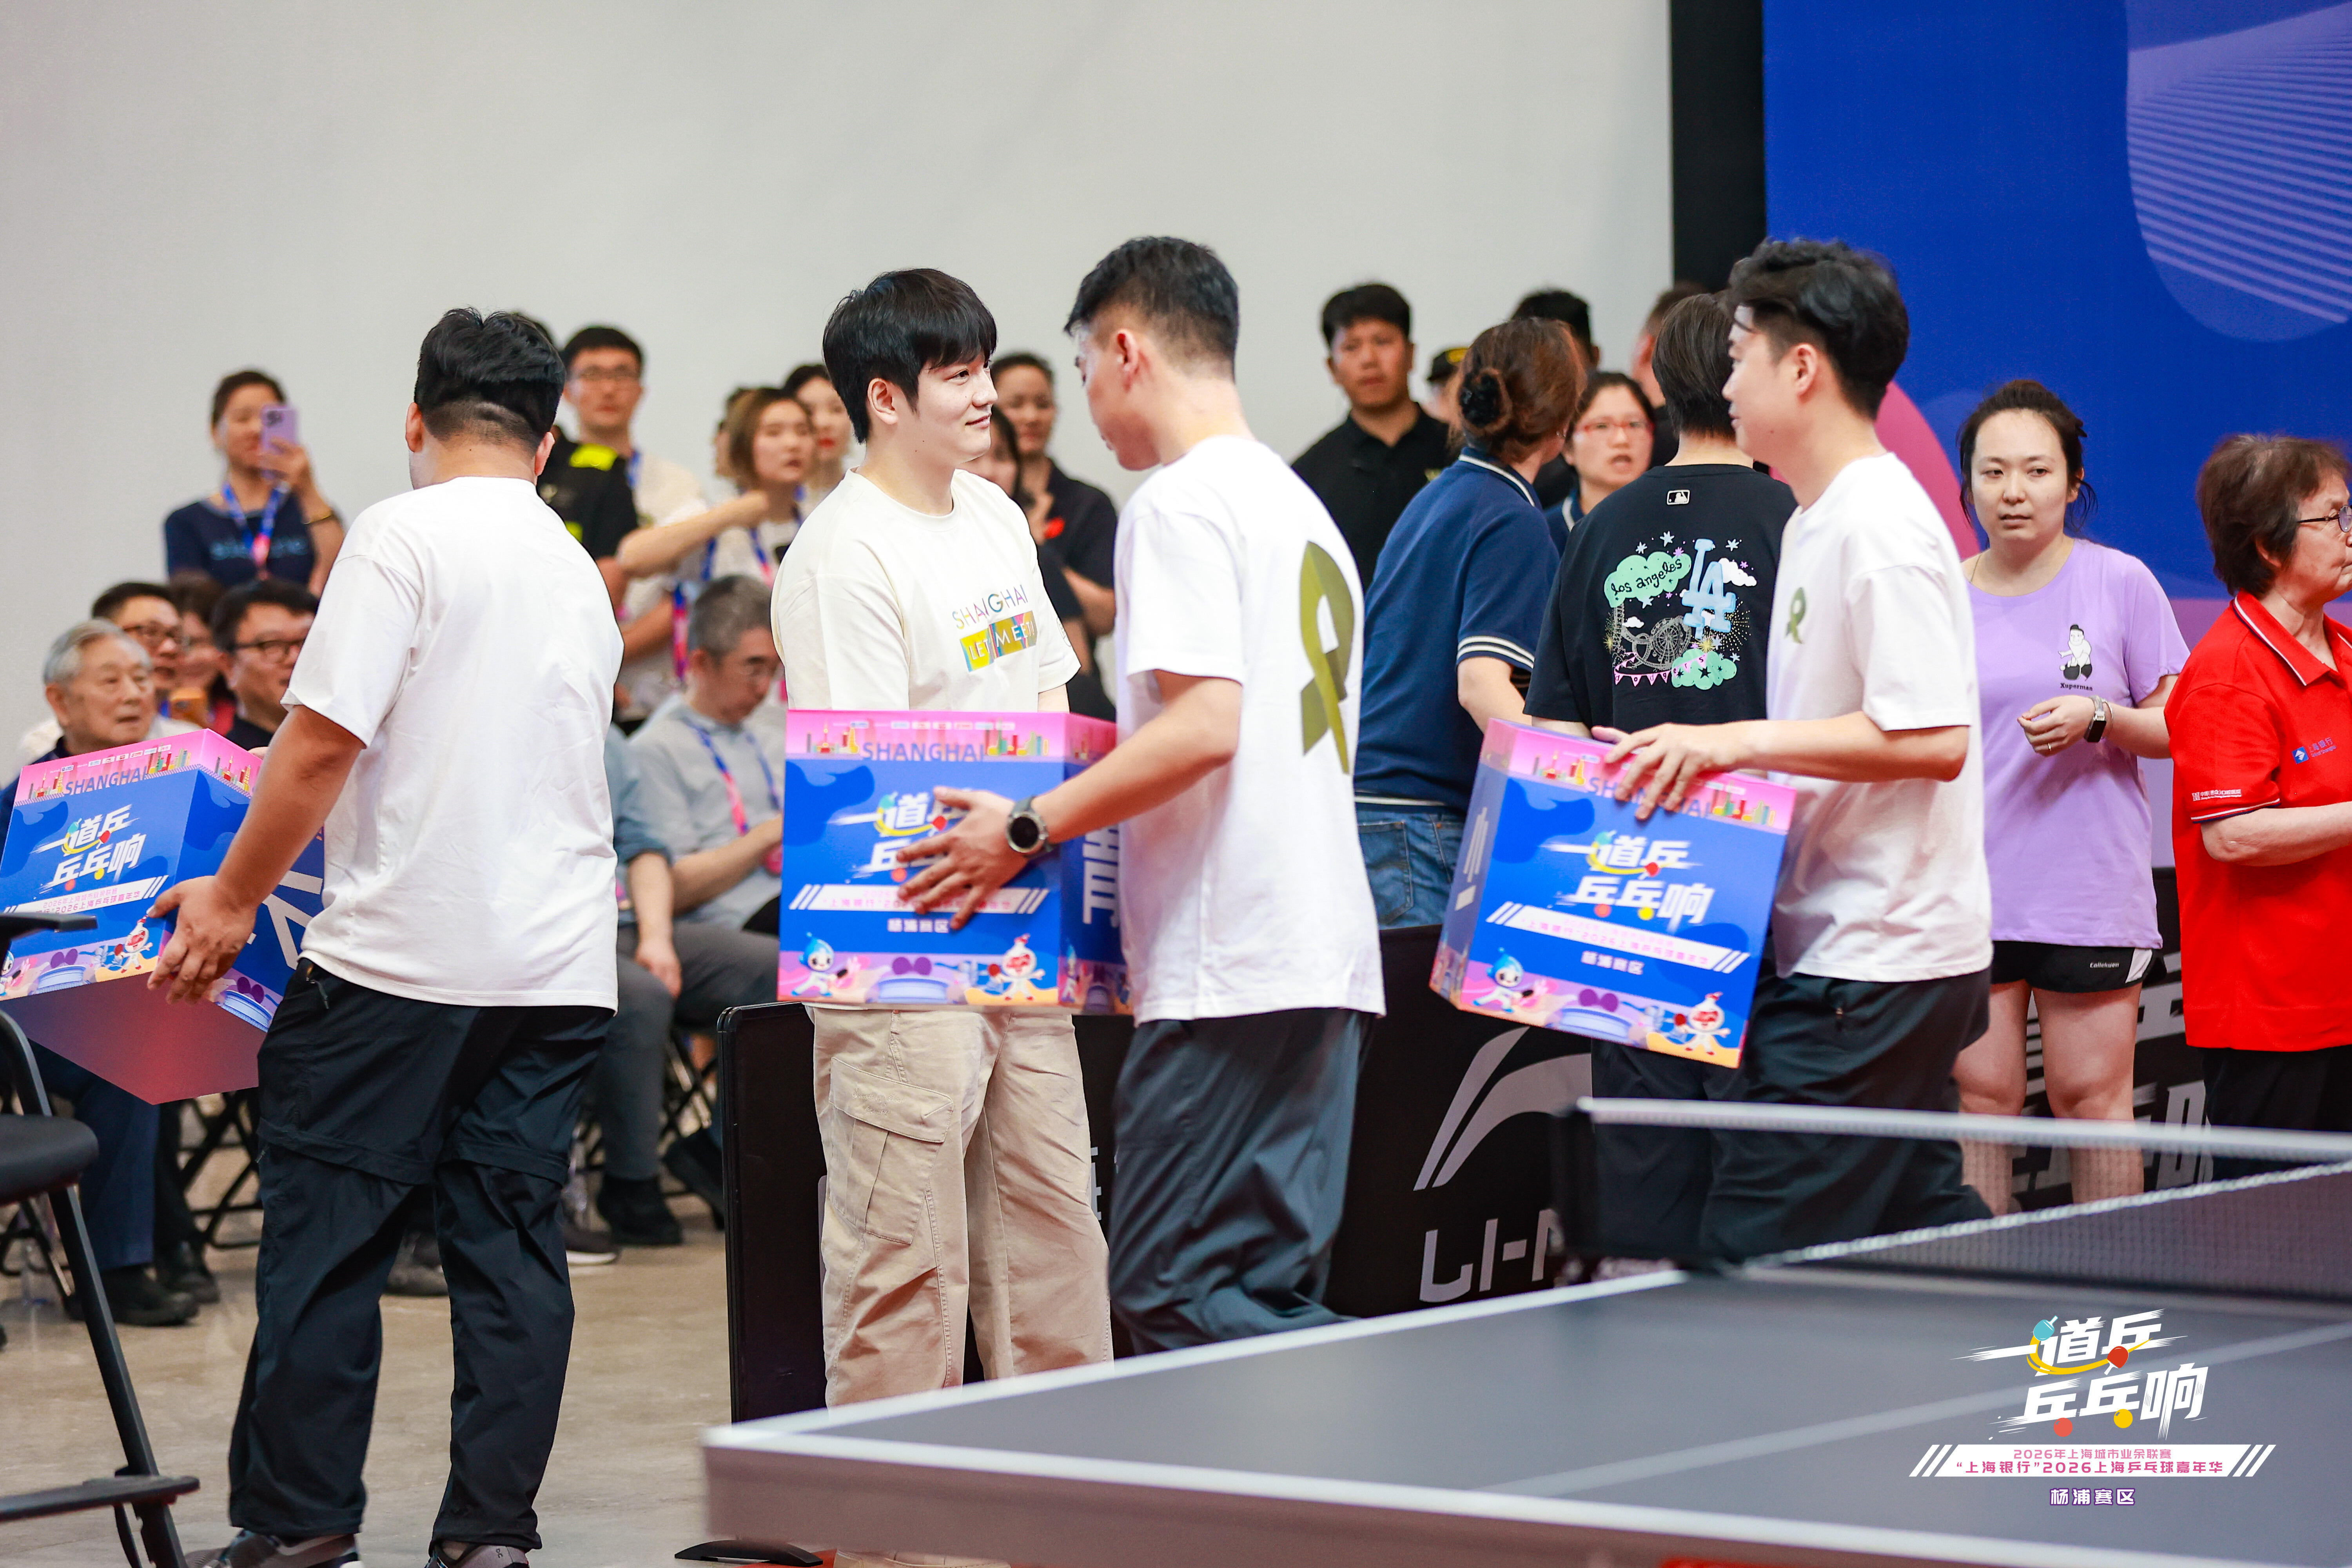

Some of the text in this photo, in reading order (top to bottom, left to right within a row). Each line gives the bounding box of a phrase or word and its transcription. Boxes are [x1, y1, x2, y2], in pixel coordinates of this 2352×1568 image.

[1611, 559, 1682, 596] los angeles
[969, 638, 991, 660] LET'
[2060, 682, 2093, 691] Xuperman
[862, 742, 985, 762] SHANGHAI
[64, 766, 148, 795] SHANGHAI
[1589, 777, 1710, 817] SHAI
